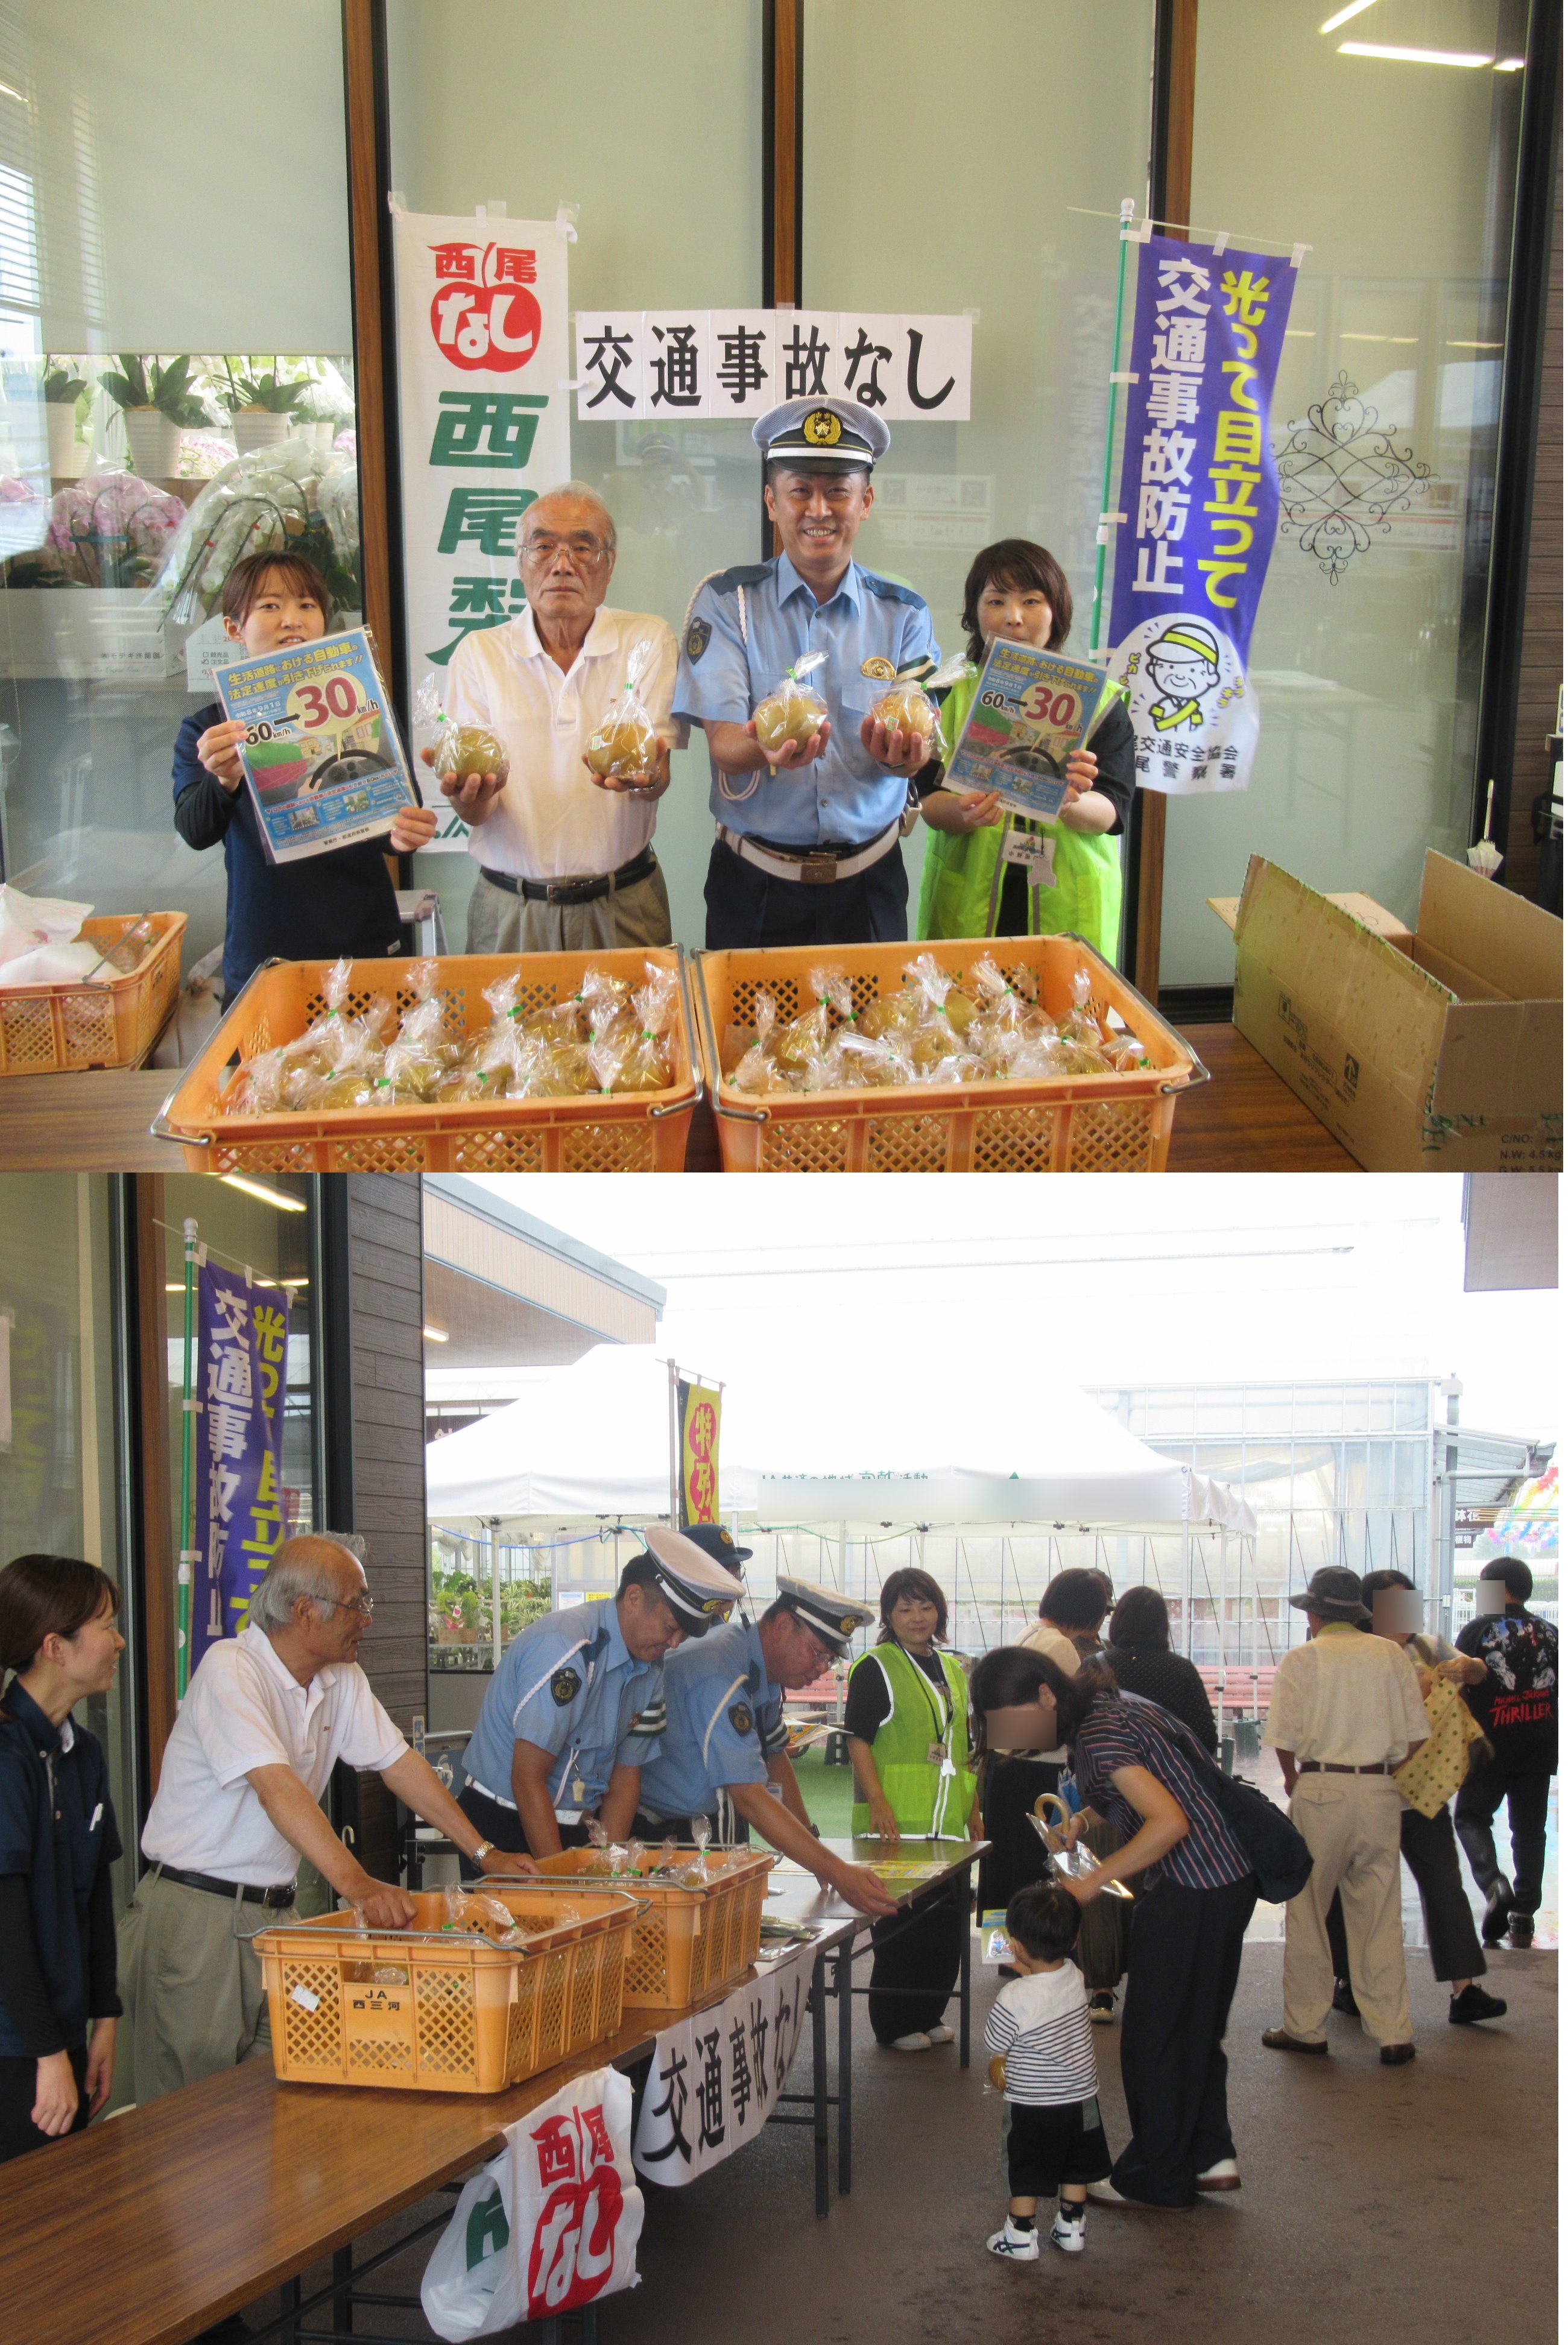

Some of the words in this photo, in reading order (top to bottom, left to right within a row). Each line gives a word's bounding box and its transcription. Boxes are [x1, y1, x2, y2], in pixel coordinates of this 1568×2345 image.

[435, 246, 538, 284] 西尾
[438, 293, 533, 359] なし
[583, 324, 956, 410] 交通事故なし
[1132, 258, 1211, 595] 交通事故防止
[1198, 270, 1270, 609] 光って目立って
[425, 391, 549, 666] 西尾梨
[228, 642, 358, 686] 生活道路における自動車の
[296, 677, 358, 728] 30
[357, 700, 379, 714] km/h
[982, 691, 1005, 709] 60
[1001, 704, 1014, 714] km/h
[1025, 686, 1075, 726] 30
[1065, 722, 1083, 733] km/h
[245, 722, 273, 745] 60
[273, 728, 291, 739] km/h
[1502, 1134, 1533, 1144] C/NO:
[1488, 1703, 1554, 1727] THRILLER
[353, 2000, 400, 2011] 西三河
[365, 1990, 387, 1999] JA
